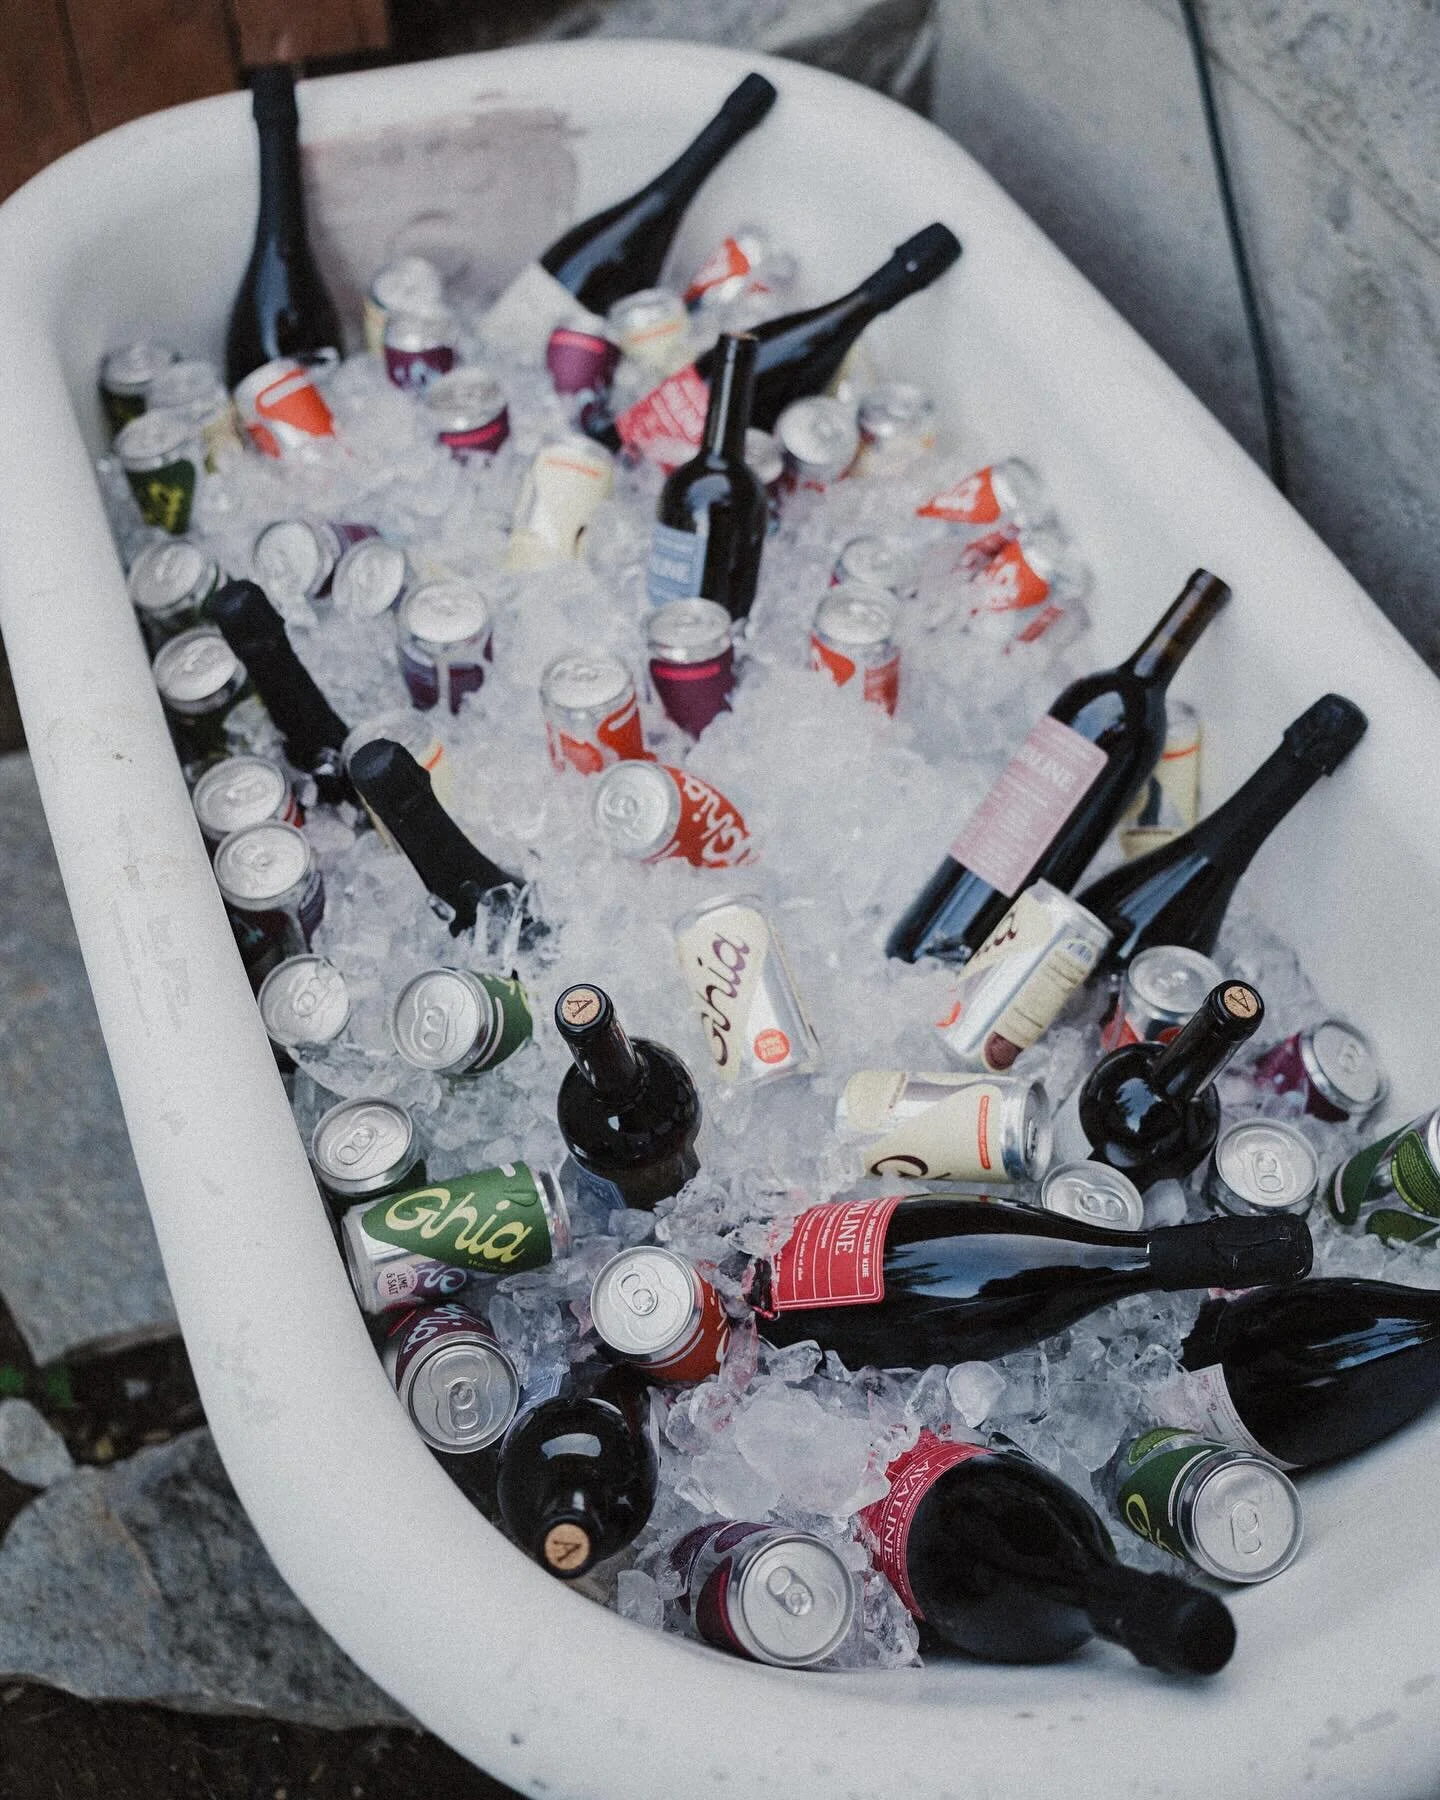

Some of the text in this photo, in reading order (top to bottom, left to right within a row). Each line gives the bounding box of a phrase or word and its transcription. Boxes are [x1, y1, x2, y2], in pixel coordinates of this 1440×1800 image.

[566, 1000, 593, 1018] A
[1228, 988, 1251, 1012] A
[385, 1187, 533, 1264] Ghia
[387, 1279, 399, 1296] SALT
[397, 1272, 409, 1291] LIME
[884, 1459, 931, 1563] AVALINE
[553, 1539, 582, 1561] A
